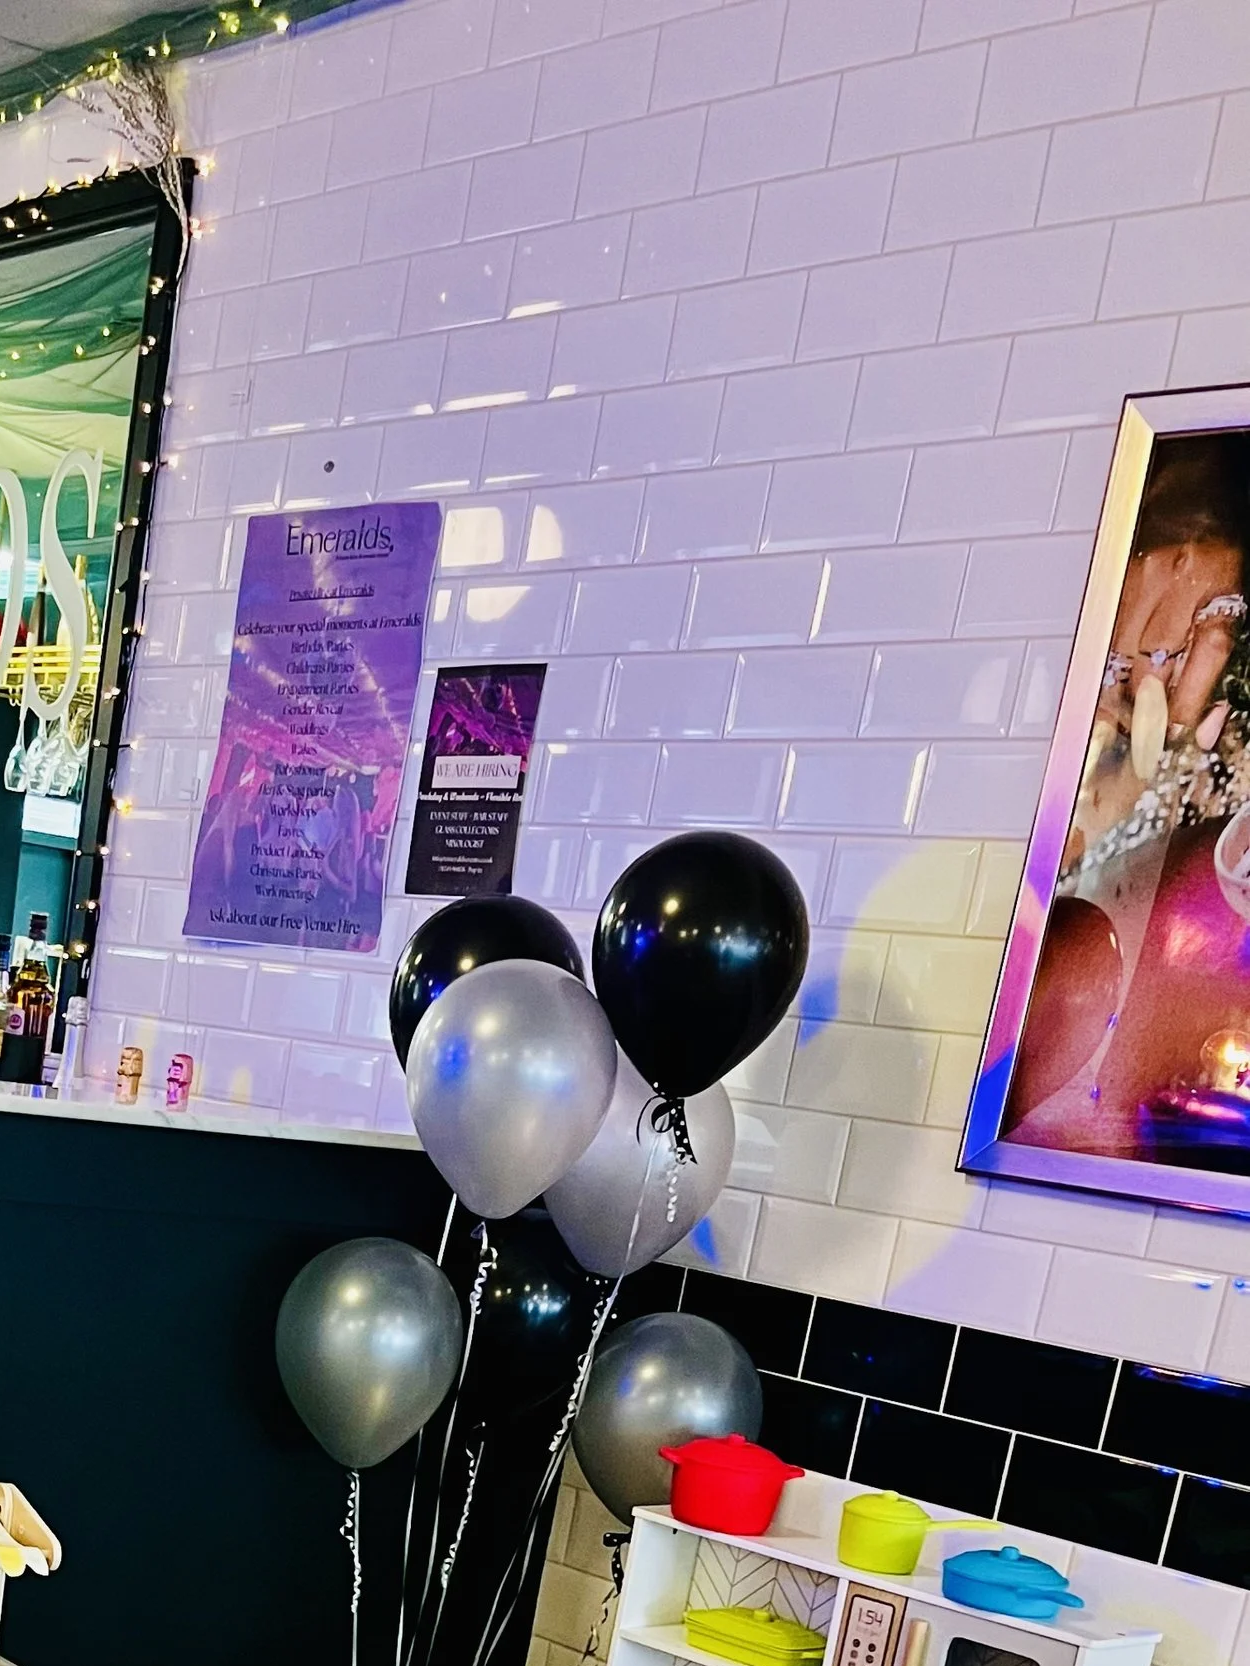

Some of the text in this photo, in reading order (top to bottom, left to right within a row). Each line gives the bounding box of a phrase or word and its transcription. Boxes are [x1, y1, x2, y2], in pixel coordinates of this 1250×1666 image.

[237, 612, 422, 637] Celebrate your special moments at Emeralds
[436, 763, 518, 778] WE ARE HIRING
[250, 843, 286, 858] Product
[250, 863, 295, 878] Christmas
[226, 908, 258, 926] about
[259, 913, 278, 927] our
[280, 912, 303, 930] Free
[304, 914, 337, 933] Venue
[337, 917, 361, 935] Hire
